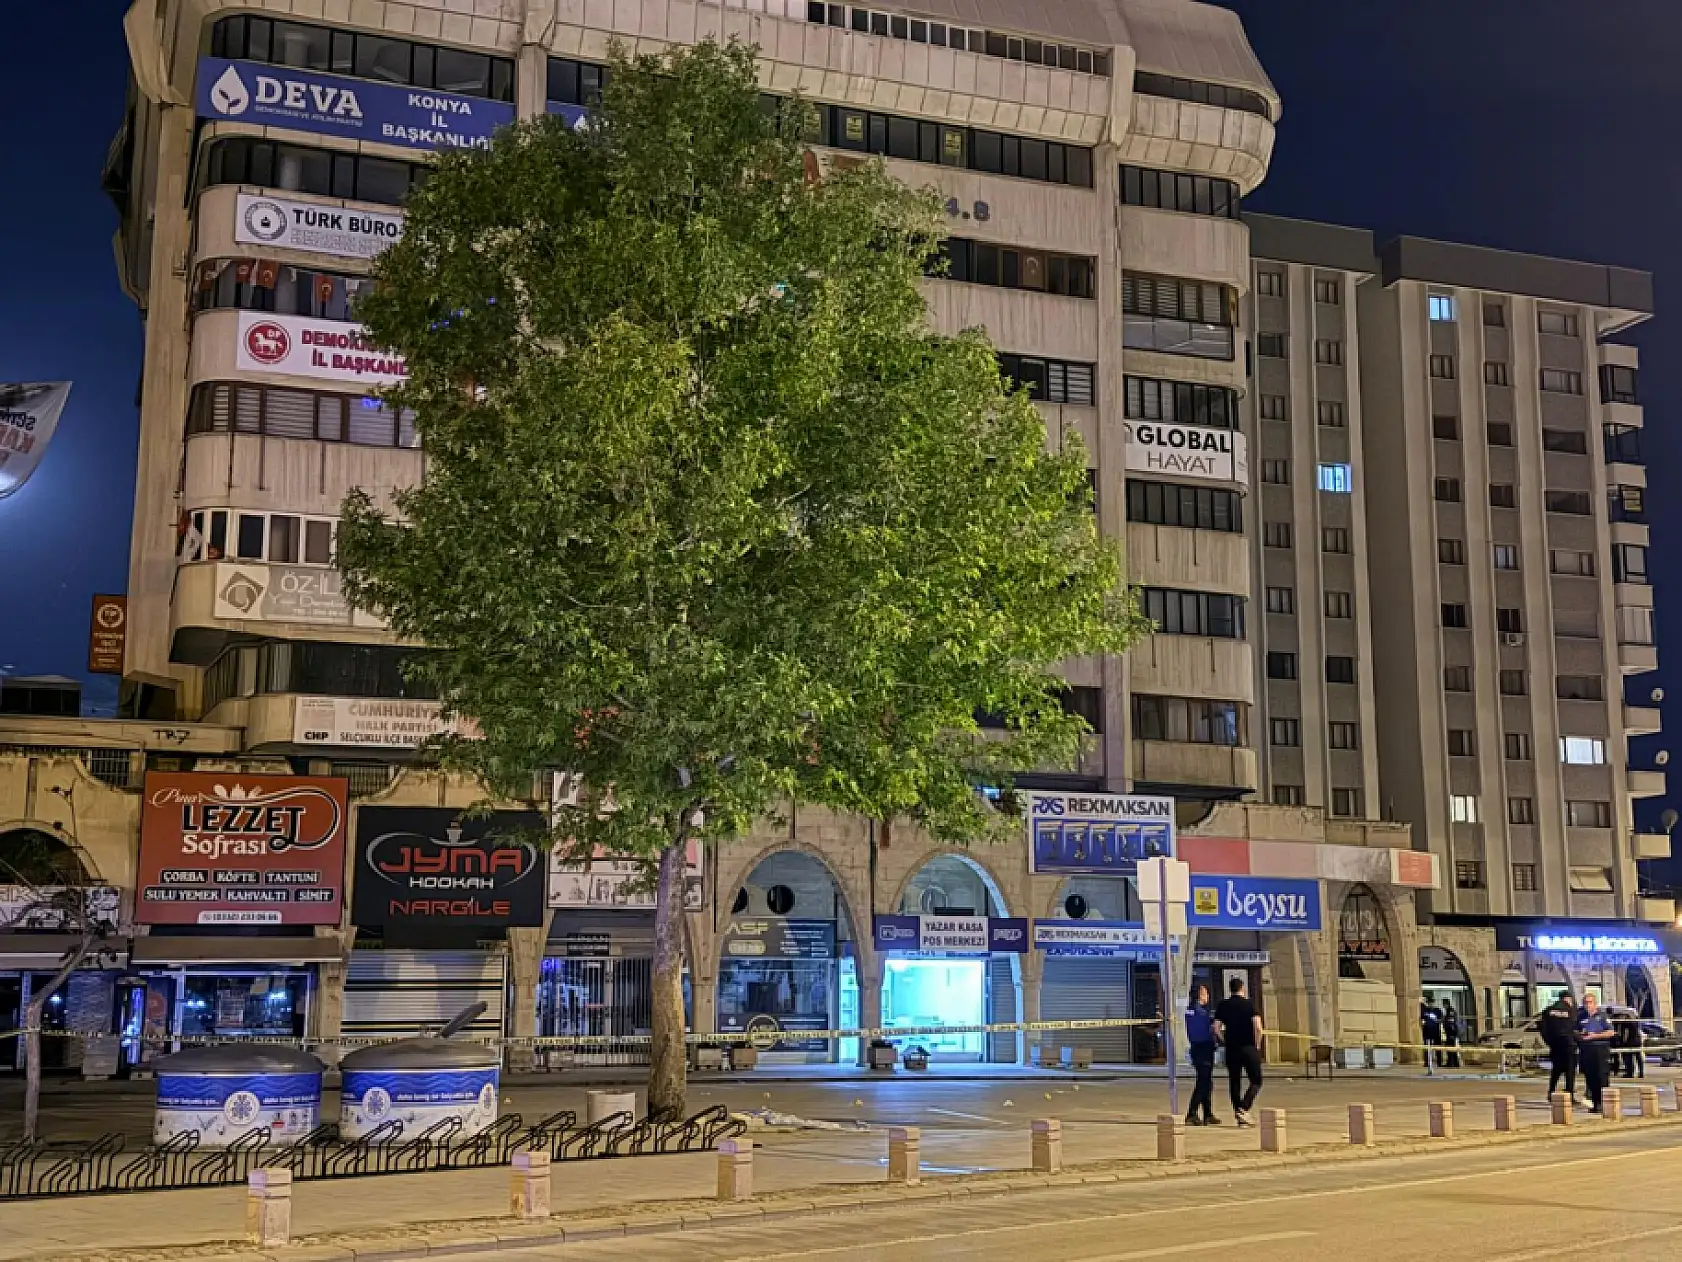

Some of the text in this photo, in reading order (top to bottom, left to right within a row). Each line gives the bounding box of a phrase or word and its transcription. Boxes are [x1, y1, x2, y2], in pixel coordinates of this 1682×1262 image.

[256, 76, 363, 118] DEVA
[408, 94, 472, 115] KONYA
[431, 111, 448, 128] İL
[292, 208, 343, 231] TÜRK
[312, 348, 329, 367] İL
[1136, 425, 1231, 453] GLOBAL
[1147, 451, 1217, 474] HAYAT
[304, 730, 328, 741] CHP
[1067, 797, 1171, 816] REXMAKSAN
[182, 804, 305, 835] LEZZET
[181, 833, 267, 860] Sofrası
[379, 847, 522, 874] JYMA
[163, 871, 205, 884] ÇORBA
[216, 871, 258, 883] KÖFTE
[409, 875, 494, 890] HOOKAH
[146, 888, 177, 901] SULU
[178, 889, 219, 901] YEMEK
[227, 888, 287, 902] KAHVALTI
[1226, 880, 1308, 925] beysu
[389, 896, 511, 916] NARGİLE
[924, 920, 984, 932] YAZAR KASA
[923, 935, 942, 947] POS
